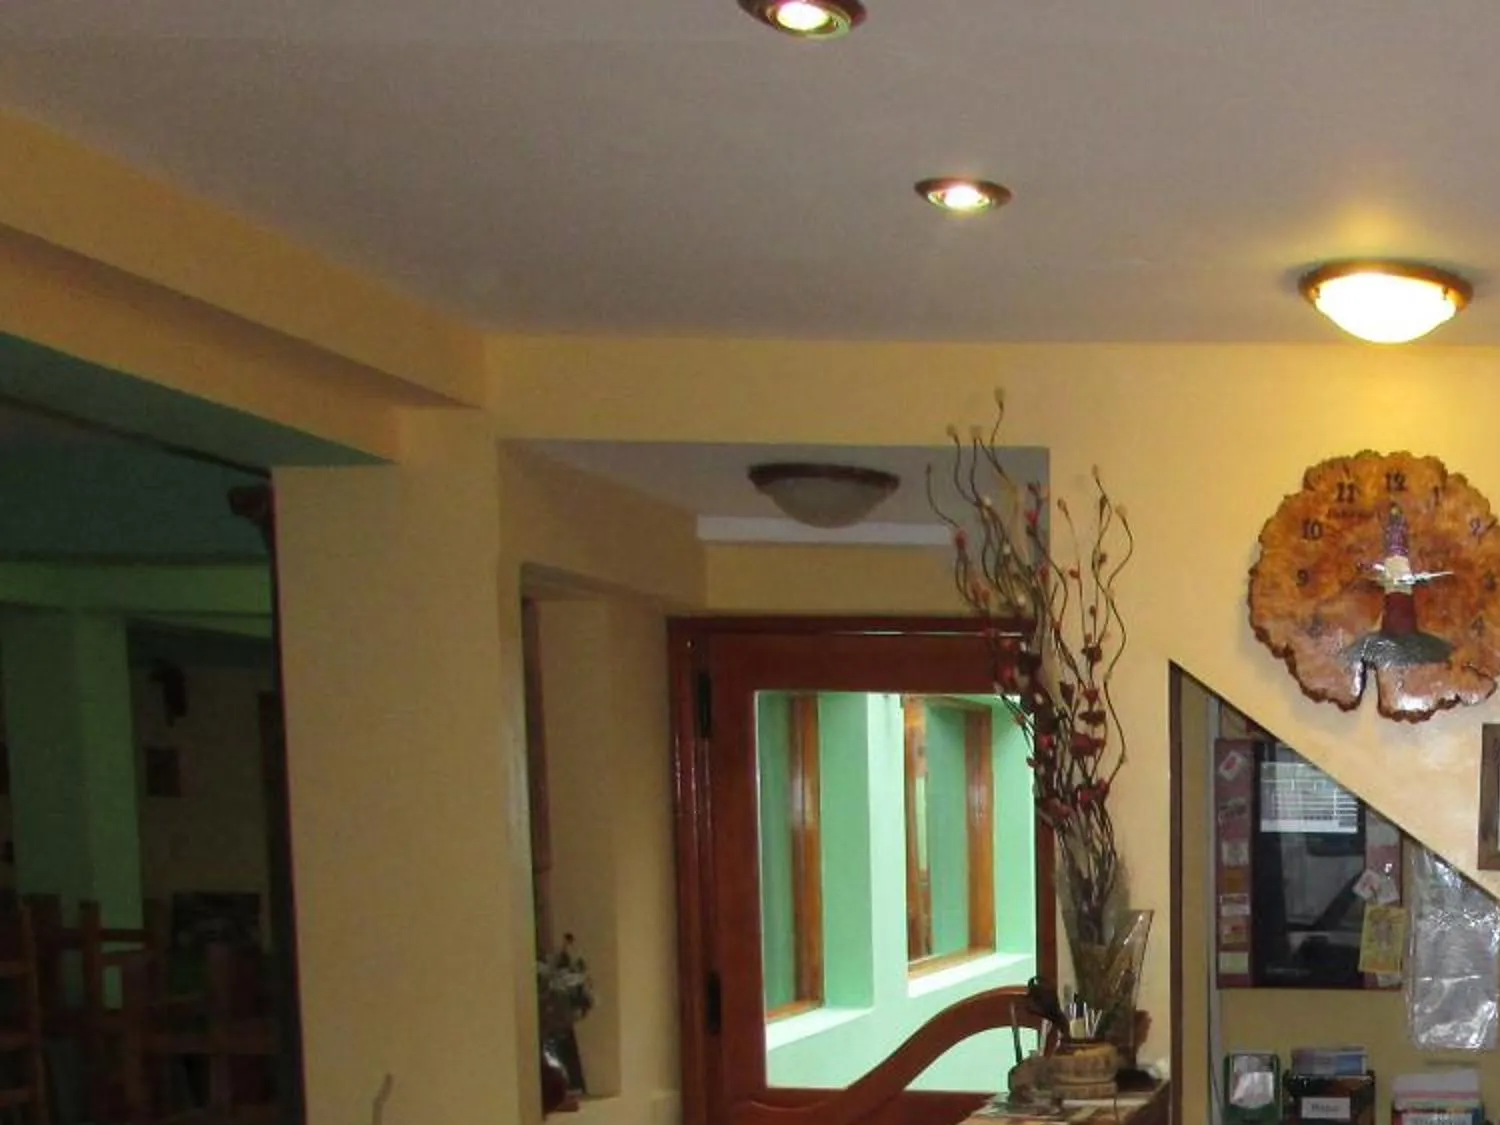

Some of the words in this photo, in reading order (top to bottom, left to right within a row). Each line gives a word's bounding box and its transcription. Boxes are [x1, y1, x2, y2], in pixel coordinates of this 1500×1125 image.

[1336, 480, 1357, 504] 11
[1385, 472, 1406, 493] 12
[1302, 518, 1323, 540] 10
[1297, 570, 1311, 589] 9
